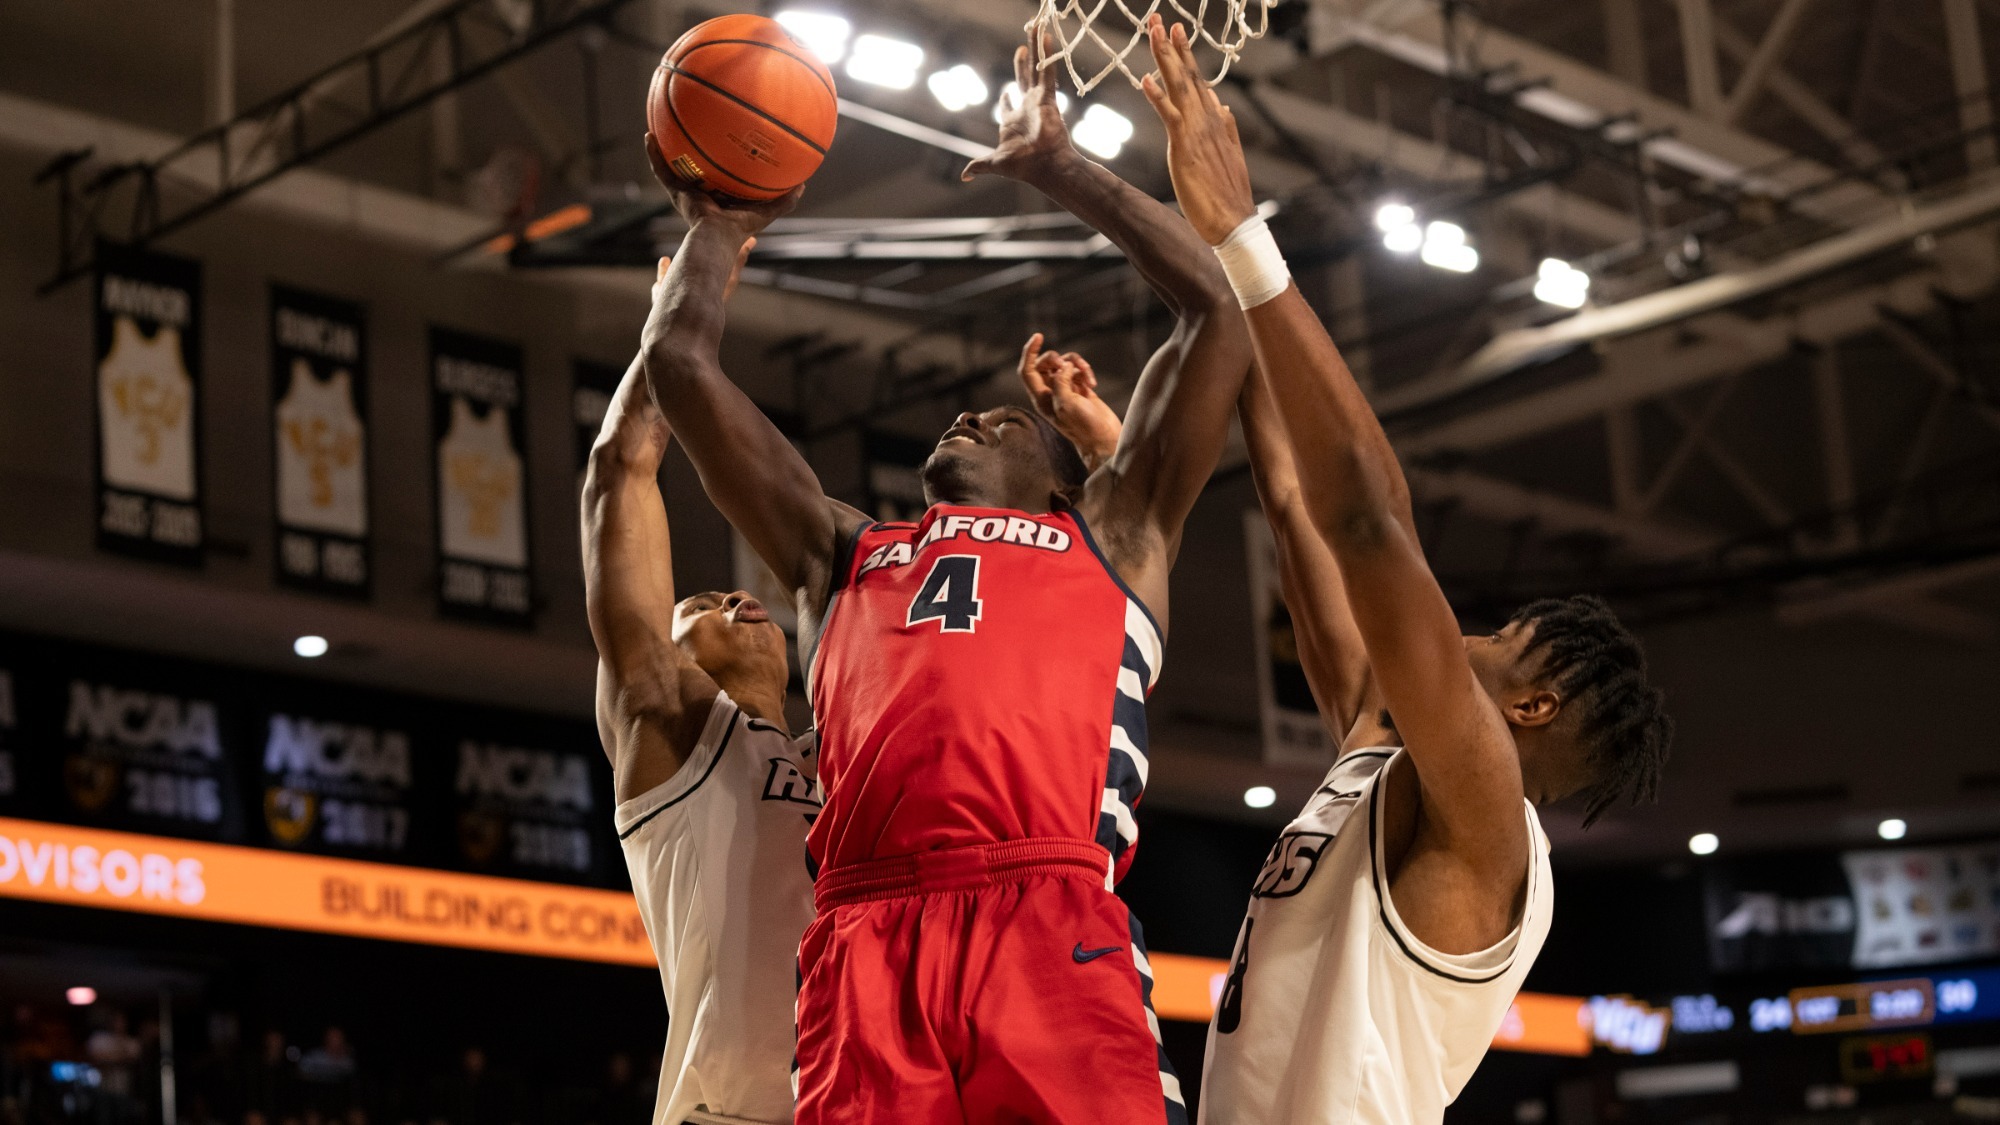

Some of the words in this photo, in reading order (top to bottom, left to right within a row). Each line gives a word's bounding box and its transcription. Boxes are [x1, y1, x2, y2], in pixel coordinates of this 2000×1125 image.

[906, 554, 983, 633] 4
[66, 681, 221, 759] NCAA
[264, 713, 413, 790] NCAA
[127, 769, 221, 824] 2016
[456, 740, 593, 813] NCAA
[321, 799, 409, 850] 2017
[321, 874, 530, 937] BUILDING
